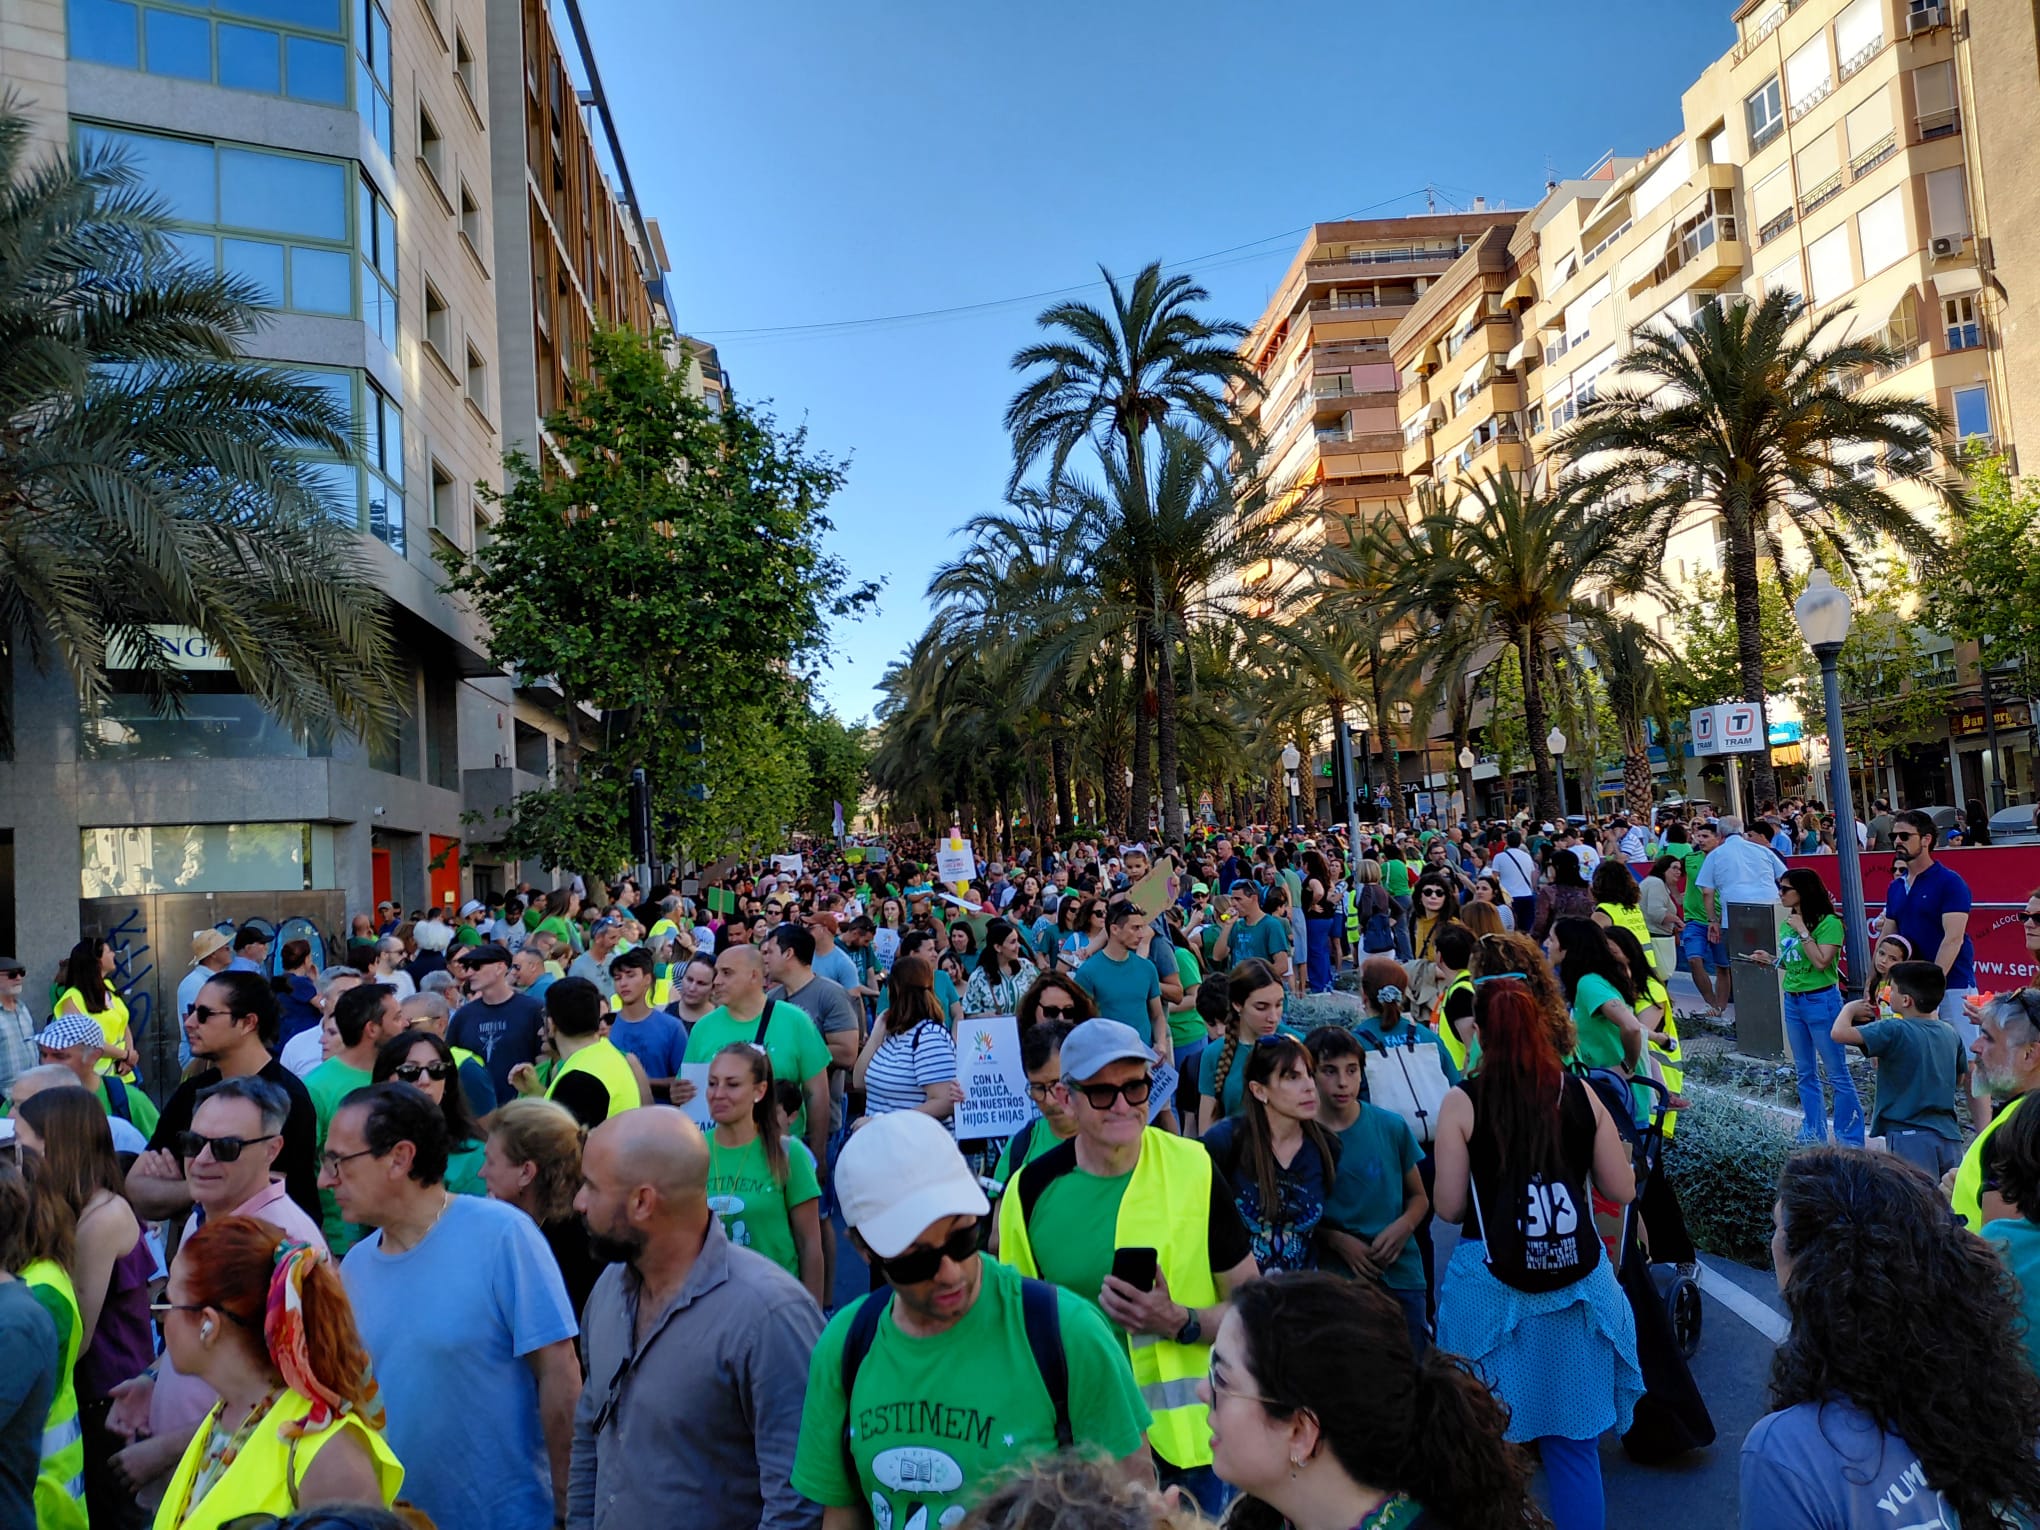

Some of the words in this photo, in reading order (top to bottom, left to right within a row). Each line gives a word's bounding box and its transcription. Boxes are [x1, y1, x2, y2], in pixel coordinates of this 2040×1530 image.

[148, 636, 208, 657] NG
[1697, 741, 1712, 749] TRAM
[1725, 737, 1752, 745] TRAM
[973, 1075, 992, 1085] CON
[993, 1073, 1004, 1083] LA
[960, 1100, 978, 1111] CON
[979, 1096, 1024, 1109] NUESTROS
[962, 1111, 989, 1127] HIJOS
[991, 1111, 997, 1123] E
[998, 1109, 1025, 1124] HIJAS
[858, 1400, 996, 1449] ESTIMEM
